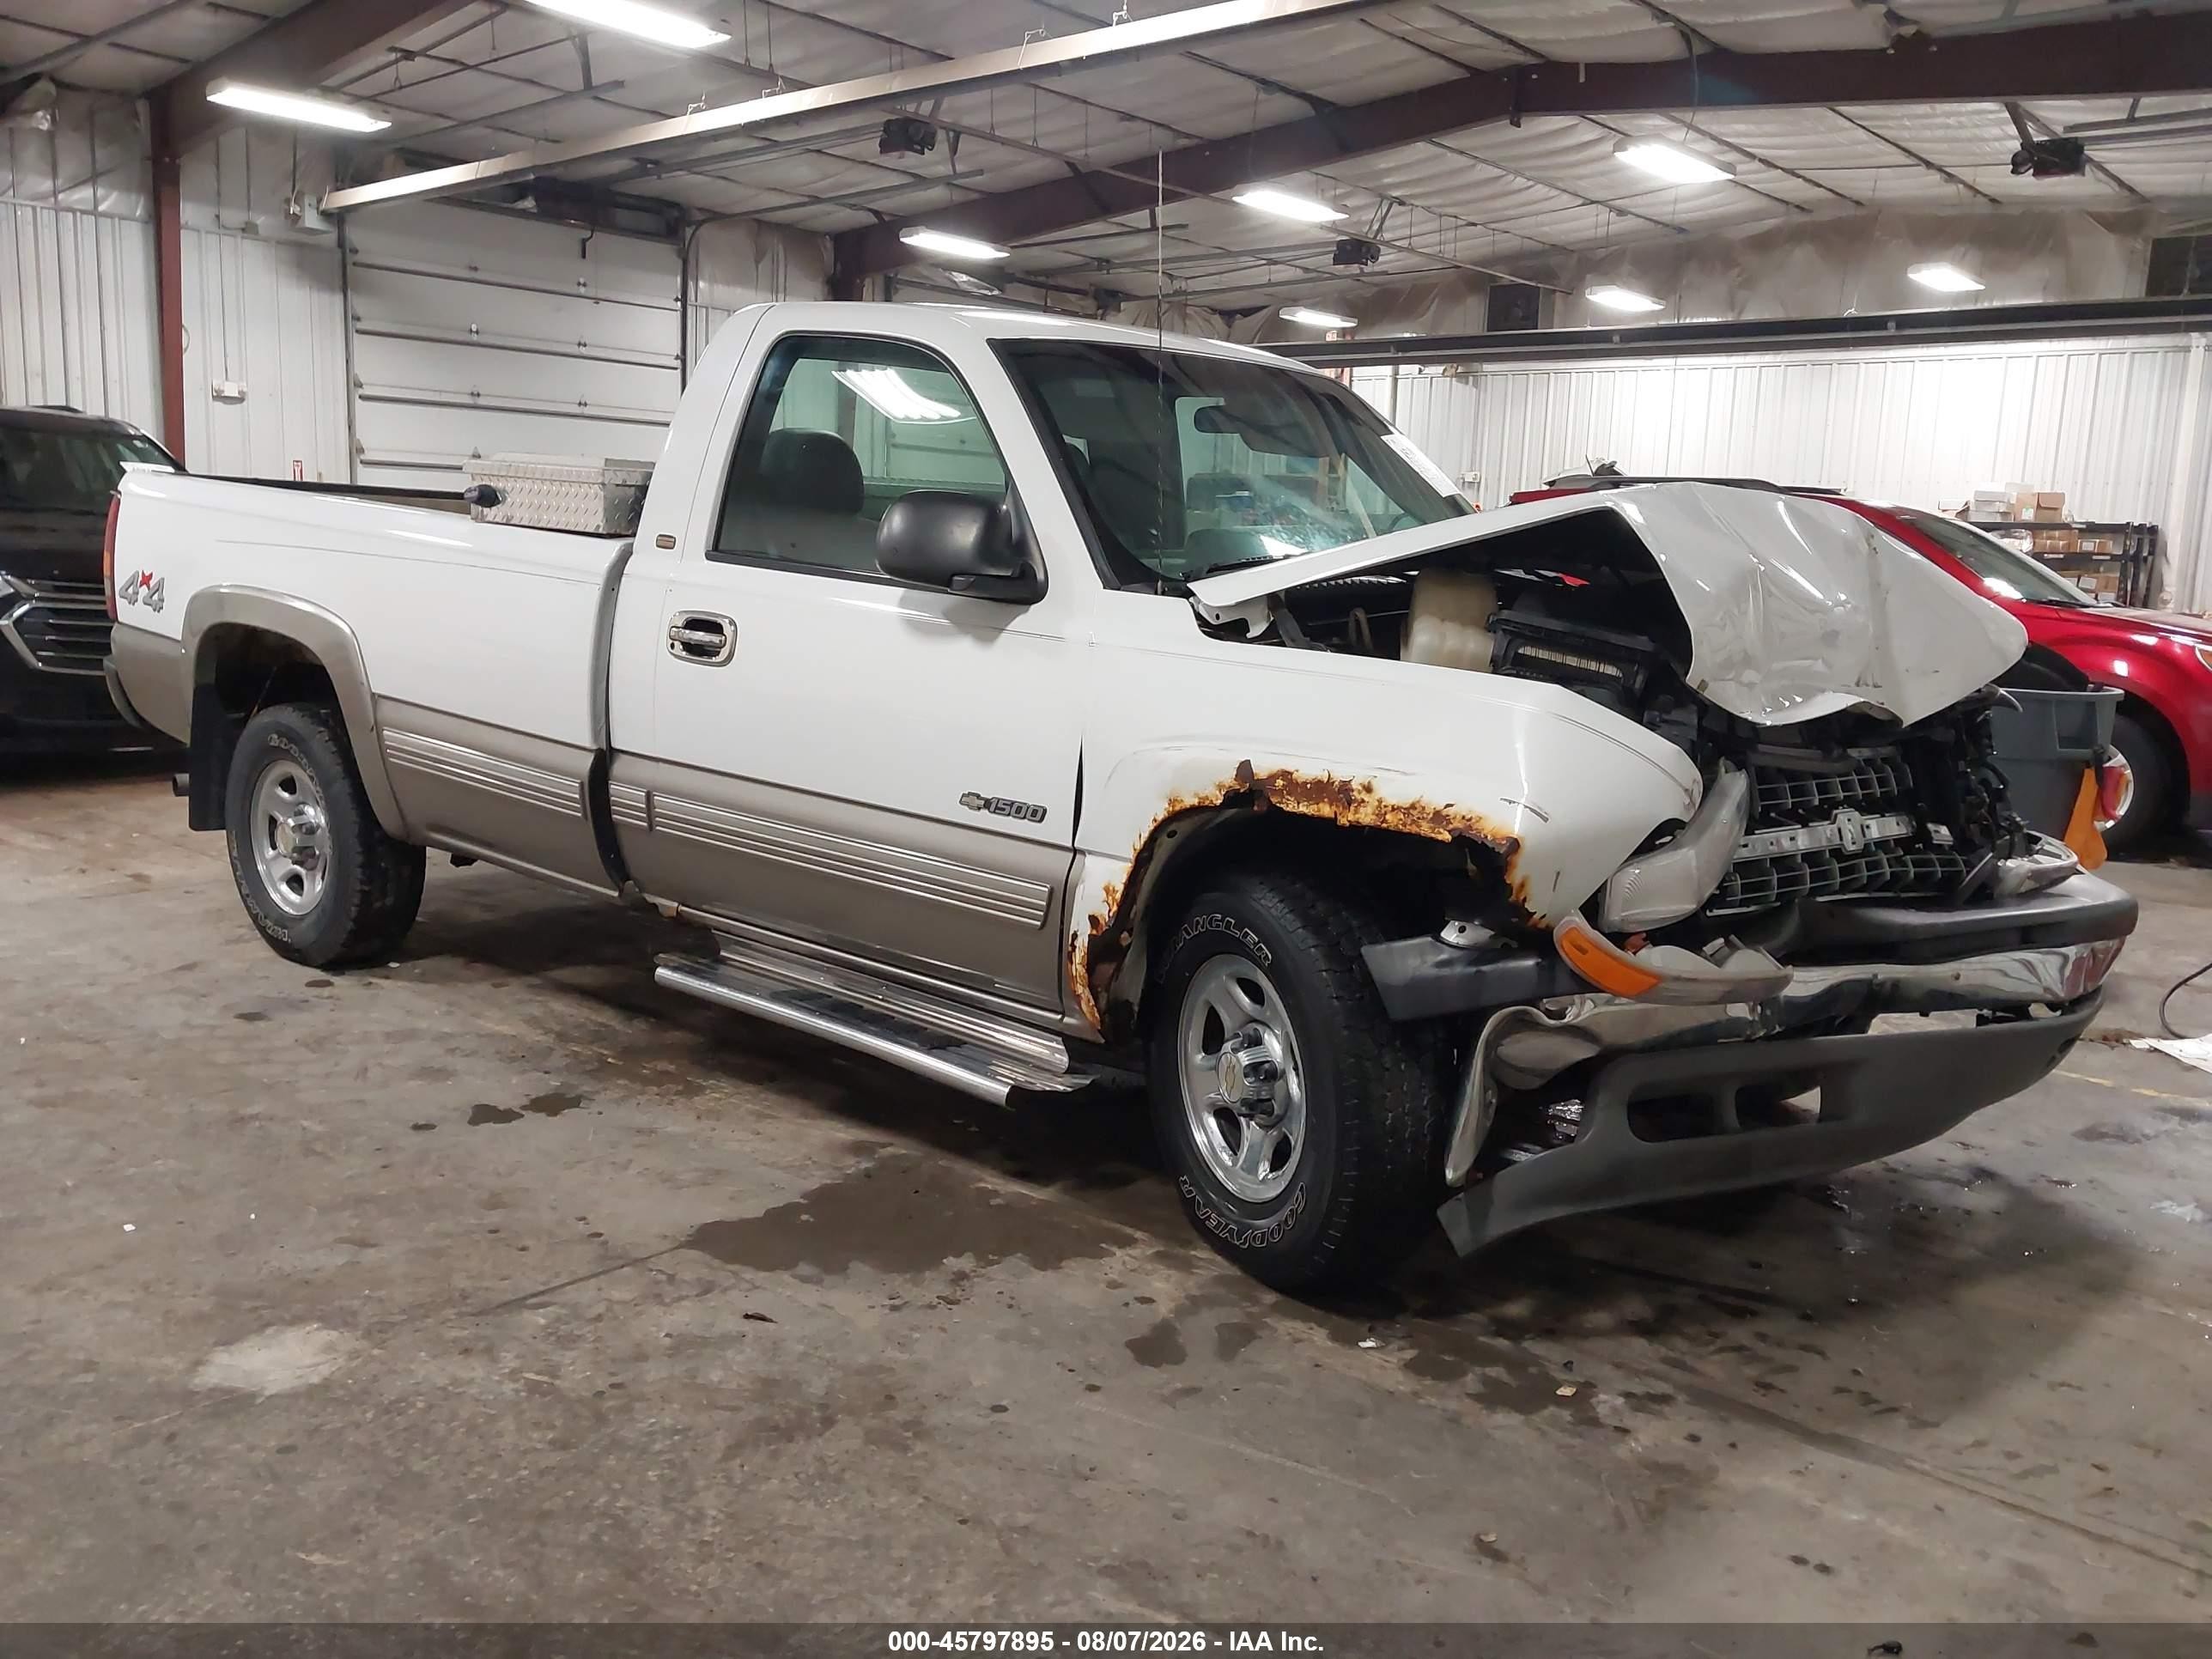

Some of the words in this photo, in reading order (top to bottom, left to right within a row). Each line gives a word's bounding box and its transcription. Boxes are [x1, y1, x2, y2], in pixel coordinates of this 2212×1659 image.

[988, 797, 1048, 823] 1500
[1156, 914, 1272, 984] ANGLER
[1179, 1175, 1306, 1249] GOODYEAR
